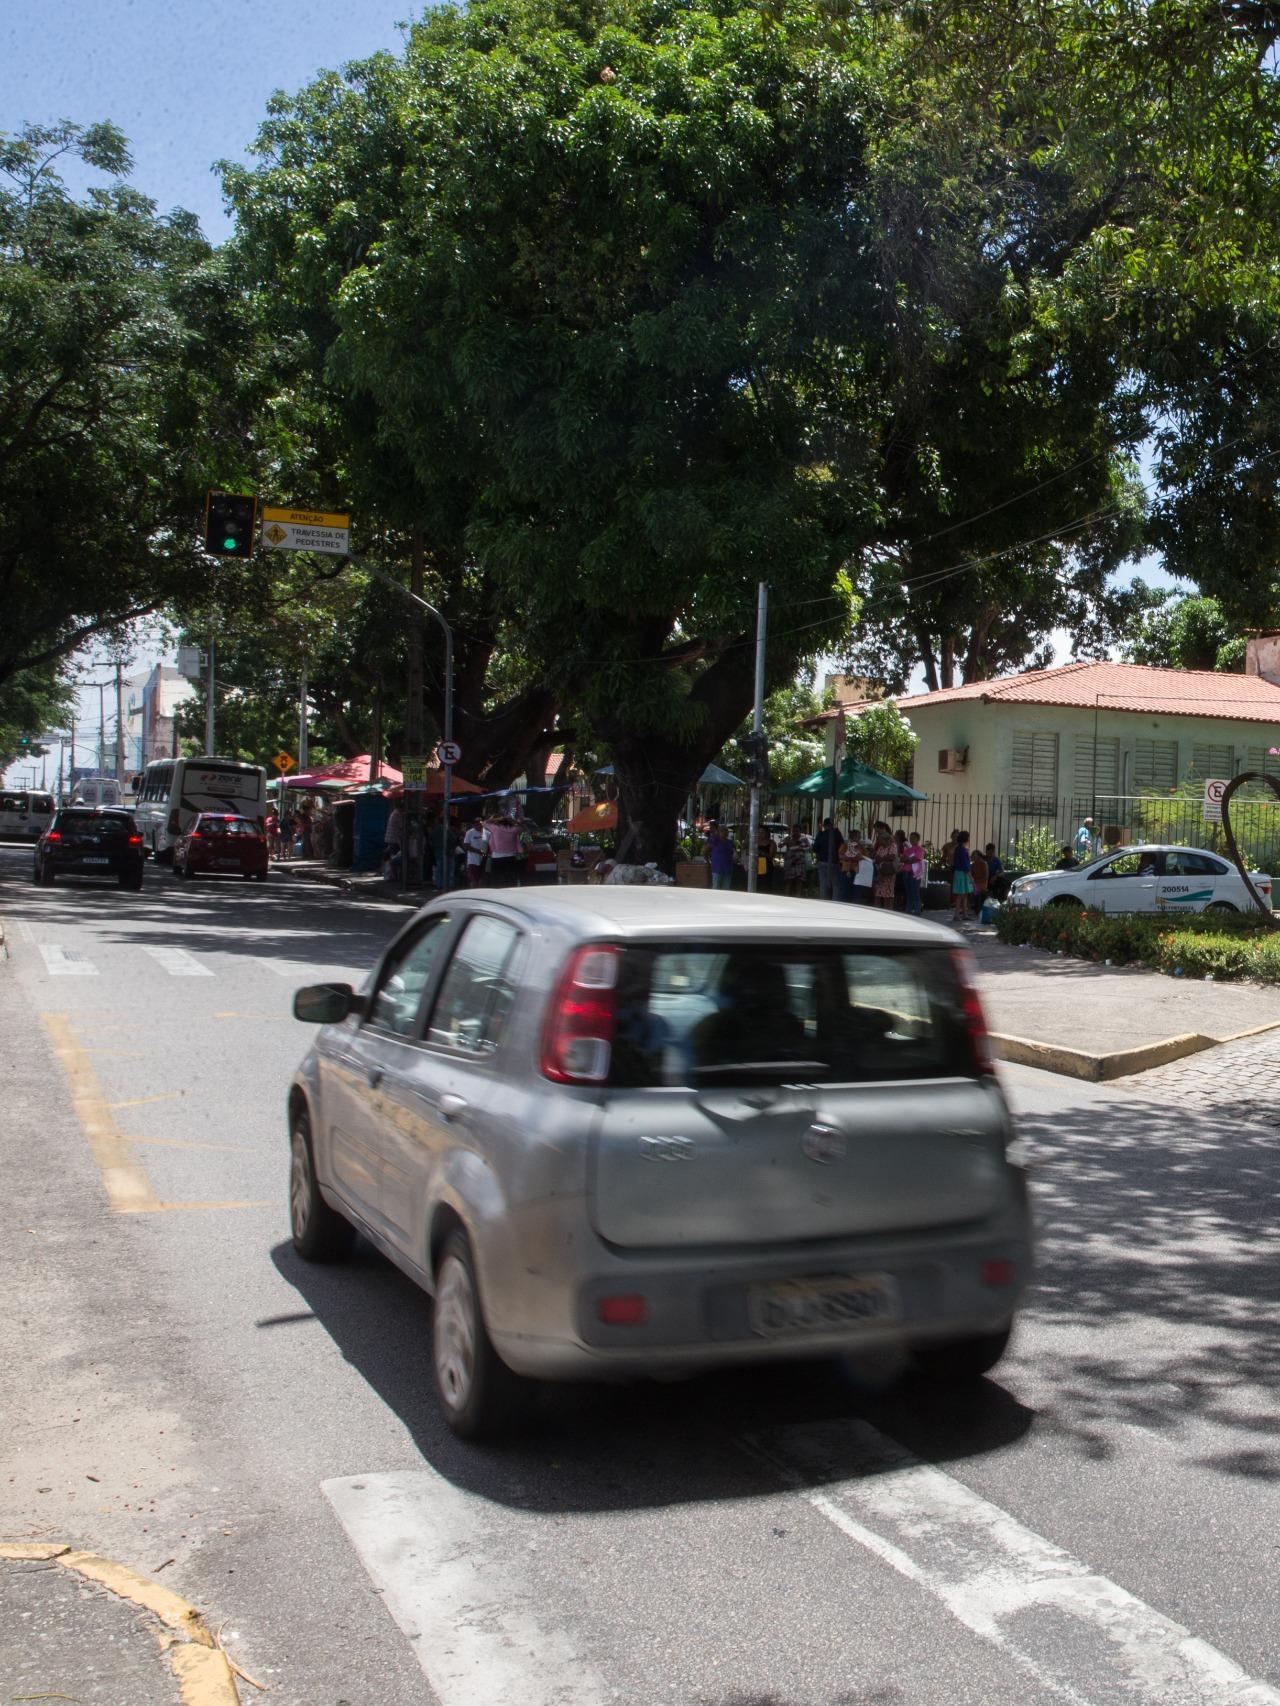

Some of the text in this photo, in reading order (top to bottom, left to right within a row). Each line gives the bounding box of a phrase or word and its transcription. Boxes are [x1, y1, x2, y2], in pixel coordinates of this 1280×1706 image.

[290, 512, 324, 524] ATENÇÃO
[291, 528, 346, 540] TRAVESSIA DE
[296, 538, 341, 549] PEDESTRES
